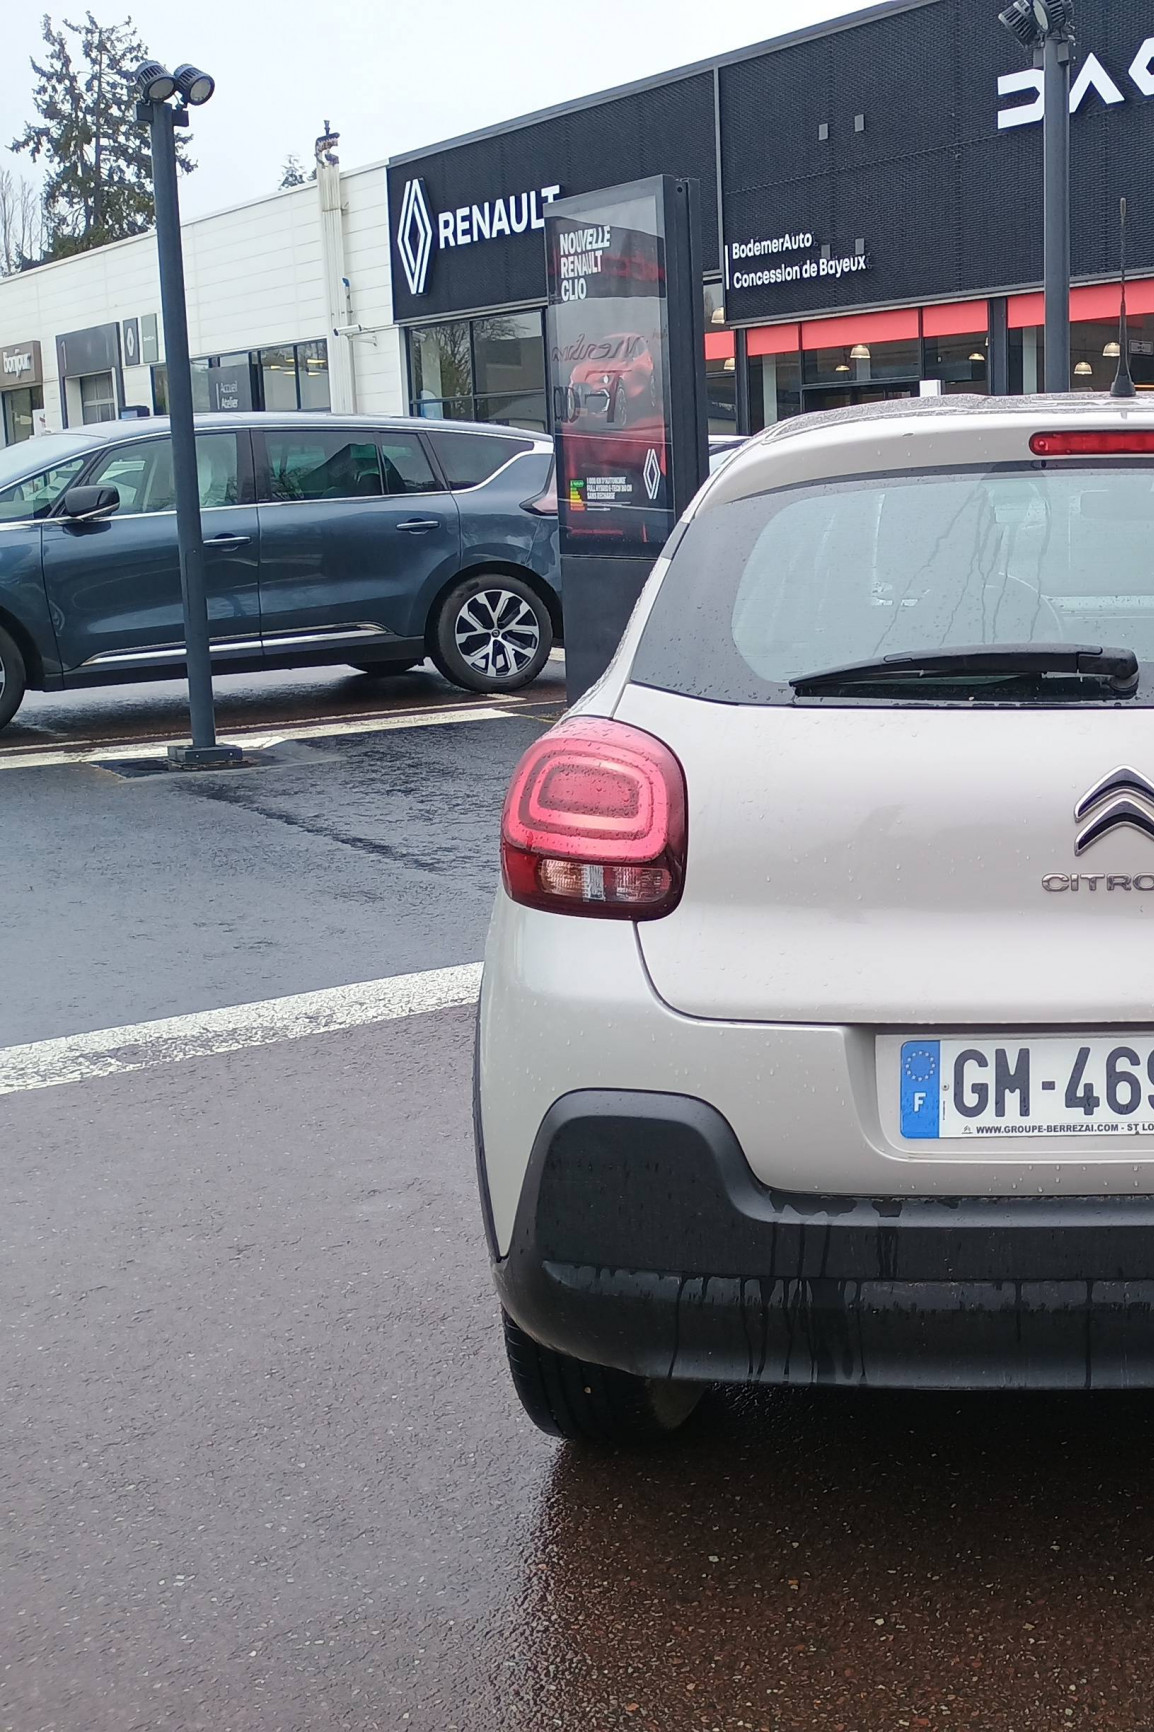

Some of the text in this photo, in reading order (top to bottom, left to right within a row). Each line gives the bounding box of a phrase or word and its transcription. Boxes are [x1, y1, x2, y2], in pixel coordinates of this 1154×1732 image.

[438, 184, 560, 250] RENAULT
[560, 225, 611, 256] NOUVELLE
[732, 232, 813, 260] BodemerAuto
[560, 249, 603, 279] RENAULT
[733, 255, 867, 289] Concession de Bayeux
[561, 278, 587, 301] CLIO
[913, 1092, 927, 1112] F
[976, 1123, 1119, 1134] WWW.GROUPE-BERREZAI.COM
[1126, 1122, 1140, 1132] ST
[1142, 1122, 1154, 1132] LO
